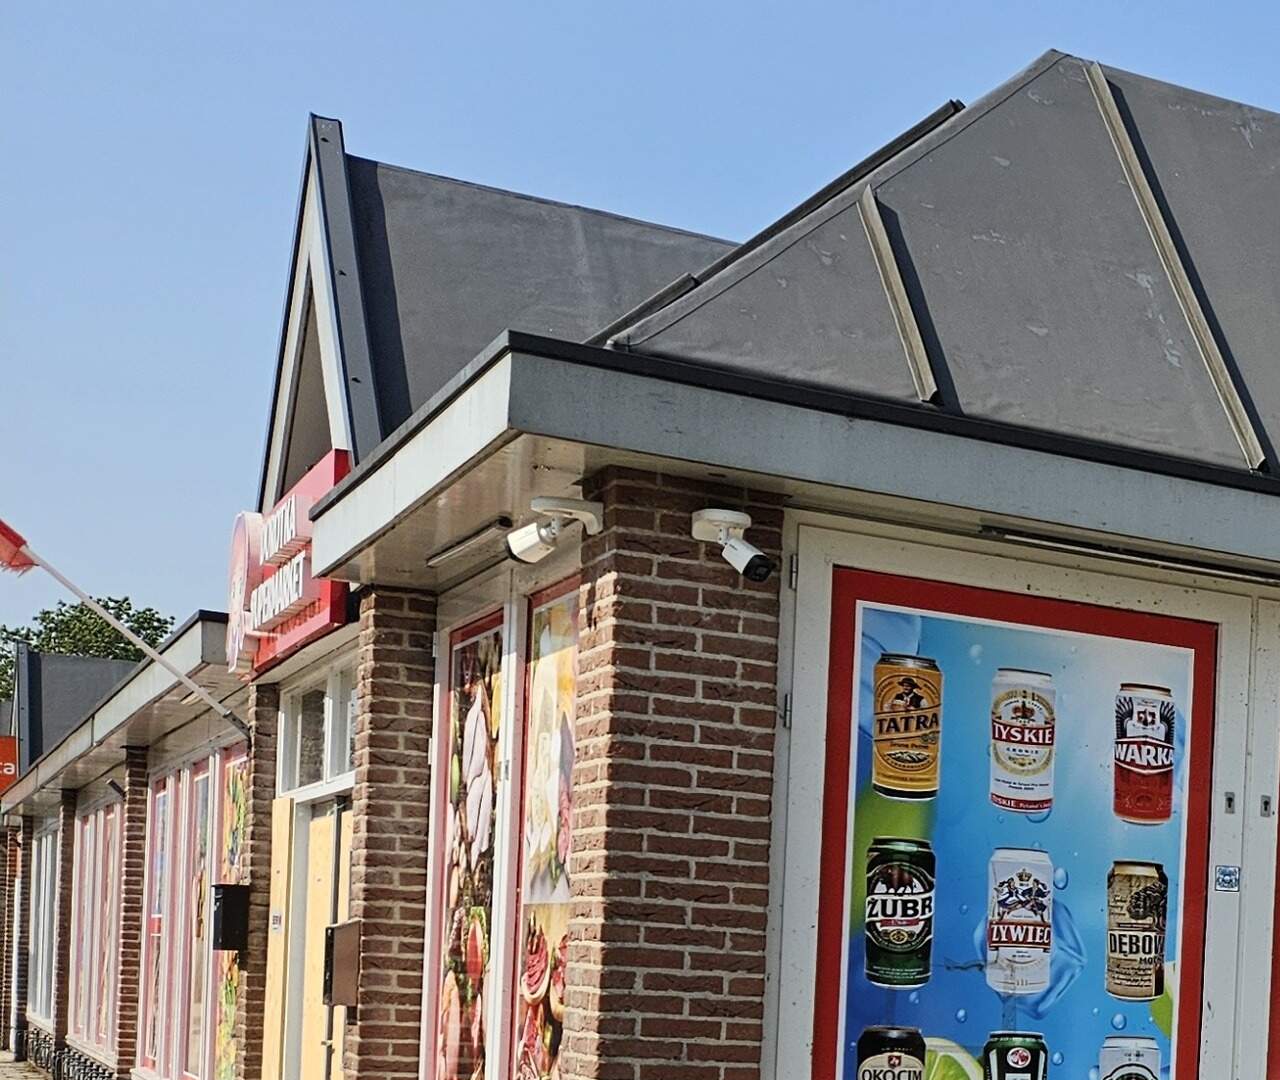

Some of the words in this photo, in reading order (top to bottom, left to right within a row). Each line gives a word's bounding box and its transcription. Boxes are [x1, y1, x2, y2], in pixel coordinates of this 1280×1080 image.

[877, 713, 939, 734] TATRA
[992, 722, 1053, 744] TYSKIE
[991, 921, 1050, 944] ŻYWIEC
